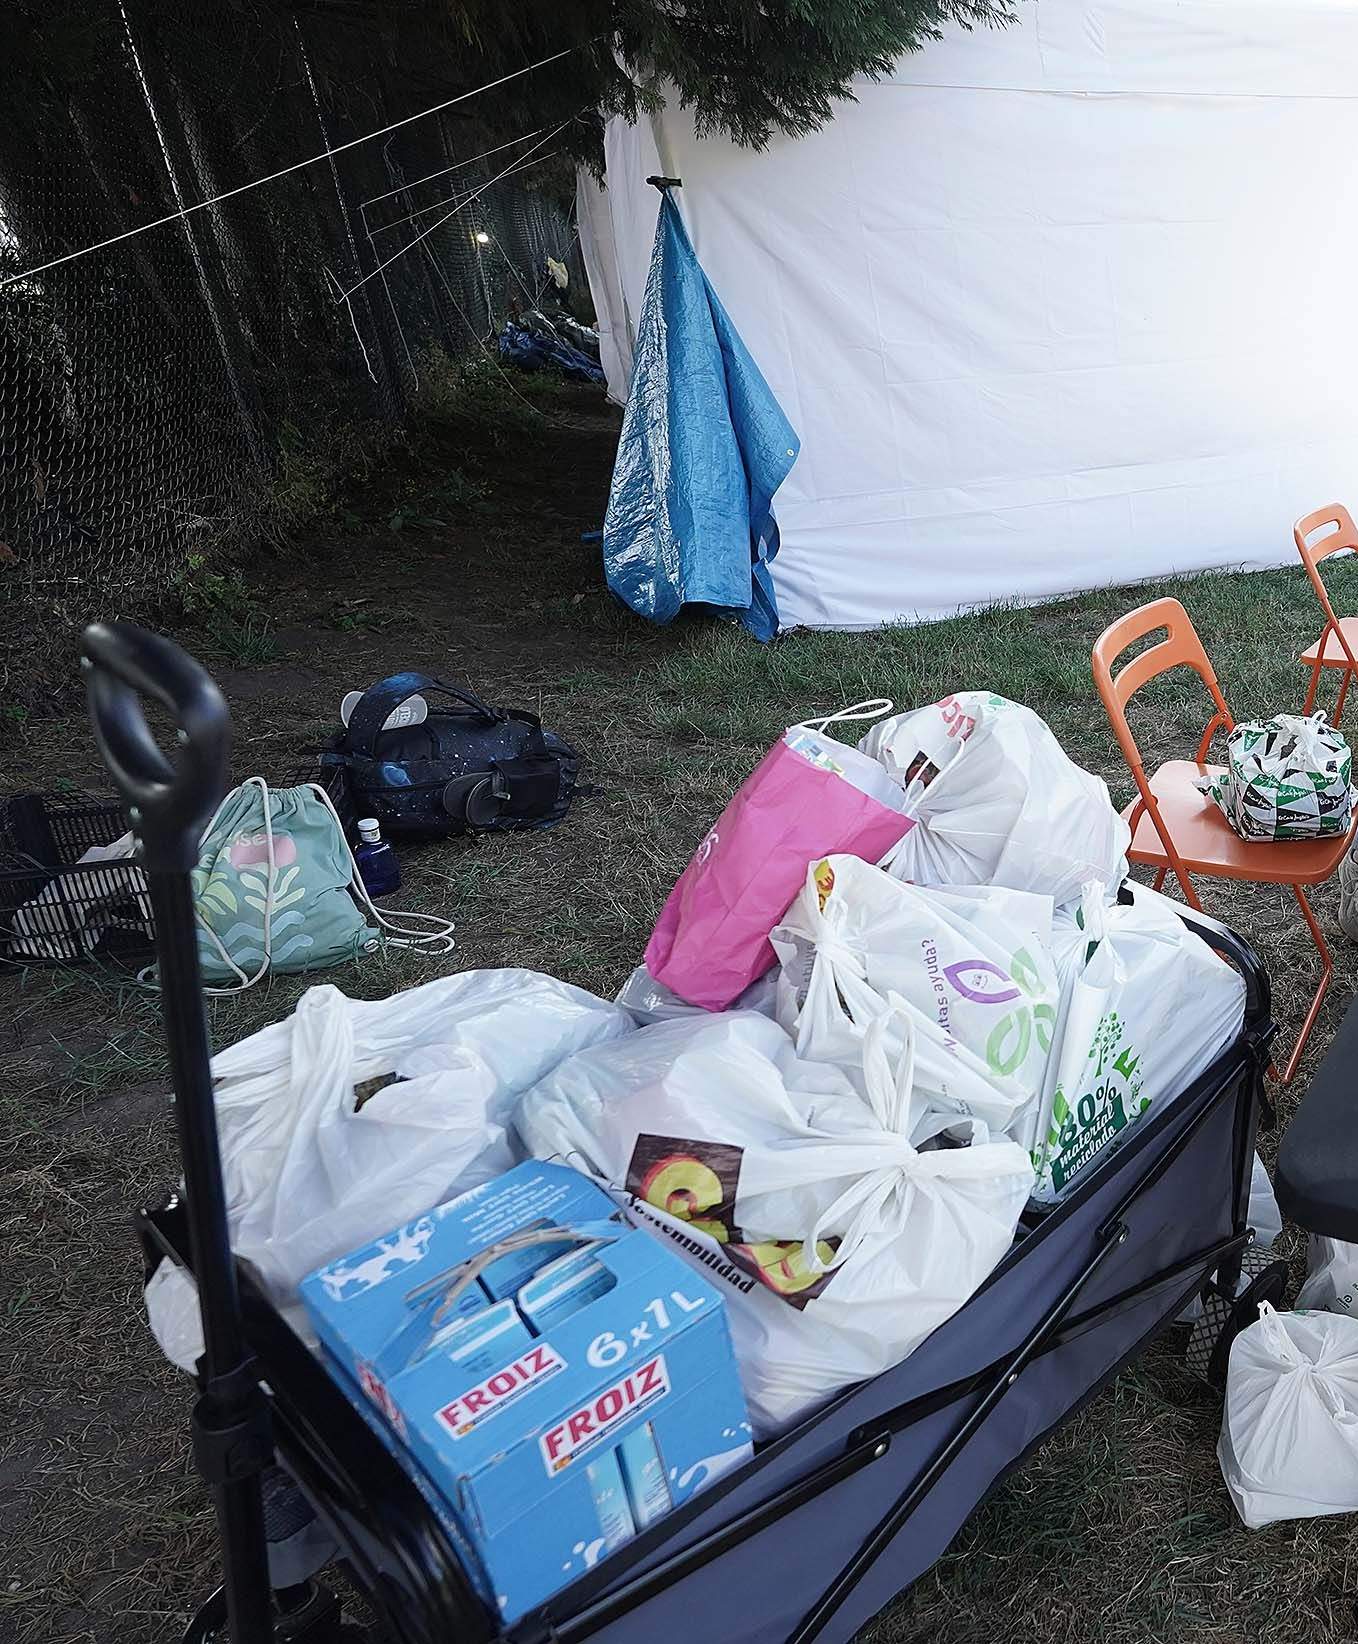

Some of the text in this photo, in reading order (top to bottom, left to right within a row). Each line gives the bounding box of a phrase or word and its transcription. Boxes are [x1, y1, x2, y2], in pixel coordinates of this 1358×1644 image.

[922, 937, 947, 994] ayuda?
[1059, 1101, 1115, 1169] material
[1063, 1126, 1116, 1181] reciclado
[440, 1347, 554, 1427] FROIZ
[545, 1359, 662, 1460] FROIZ
